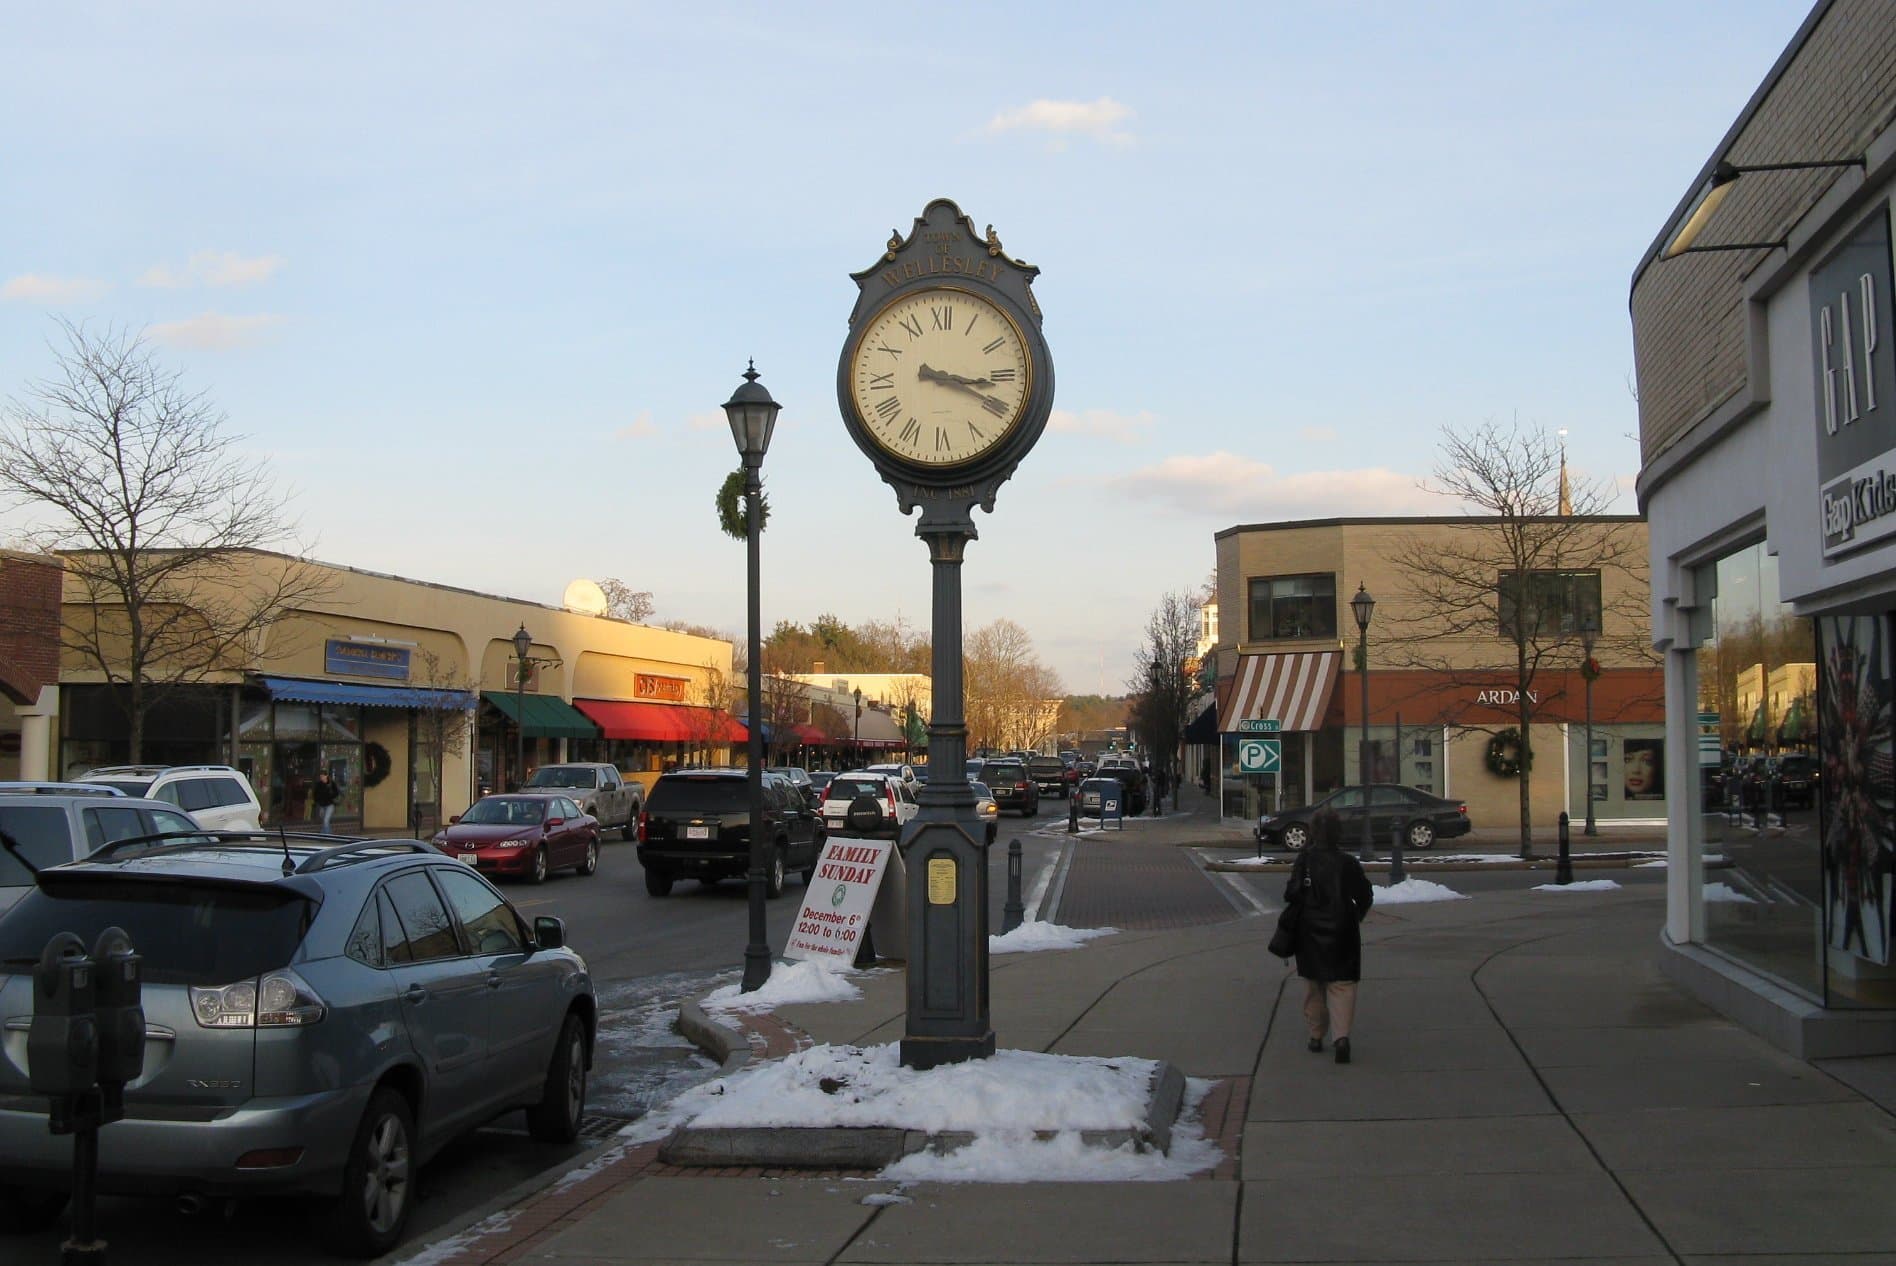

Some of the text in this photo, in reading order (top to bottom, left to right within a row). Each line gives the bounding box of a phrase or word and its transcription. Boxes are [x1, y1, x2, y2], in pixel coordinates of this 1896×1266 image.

[882, 256, 1004, 288] WELLESLEY
[931, 306, 952, 331] XII
[877, 340, 903, 361] X
[1820, 273, 1877, 436] GAP
[1475, 689, 1539, 704] ARDAN
[1250, 720, 1272, 730] Cross
[1247, 746, 1261, 766] P
[825, 845, 882, 864] FAMILY
[819, 863, 876, 884] SUNDAY
[802, 907, 847, 924] December
[799, 921, 820, 936] 12:00
[822, 926, 832, 937] to
